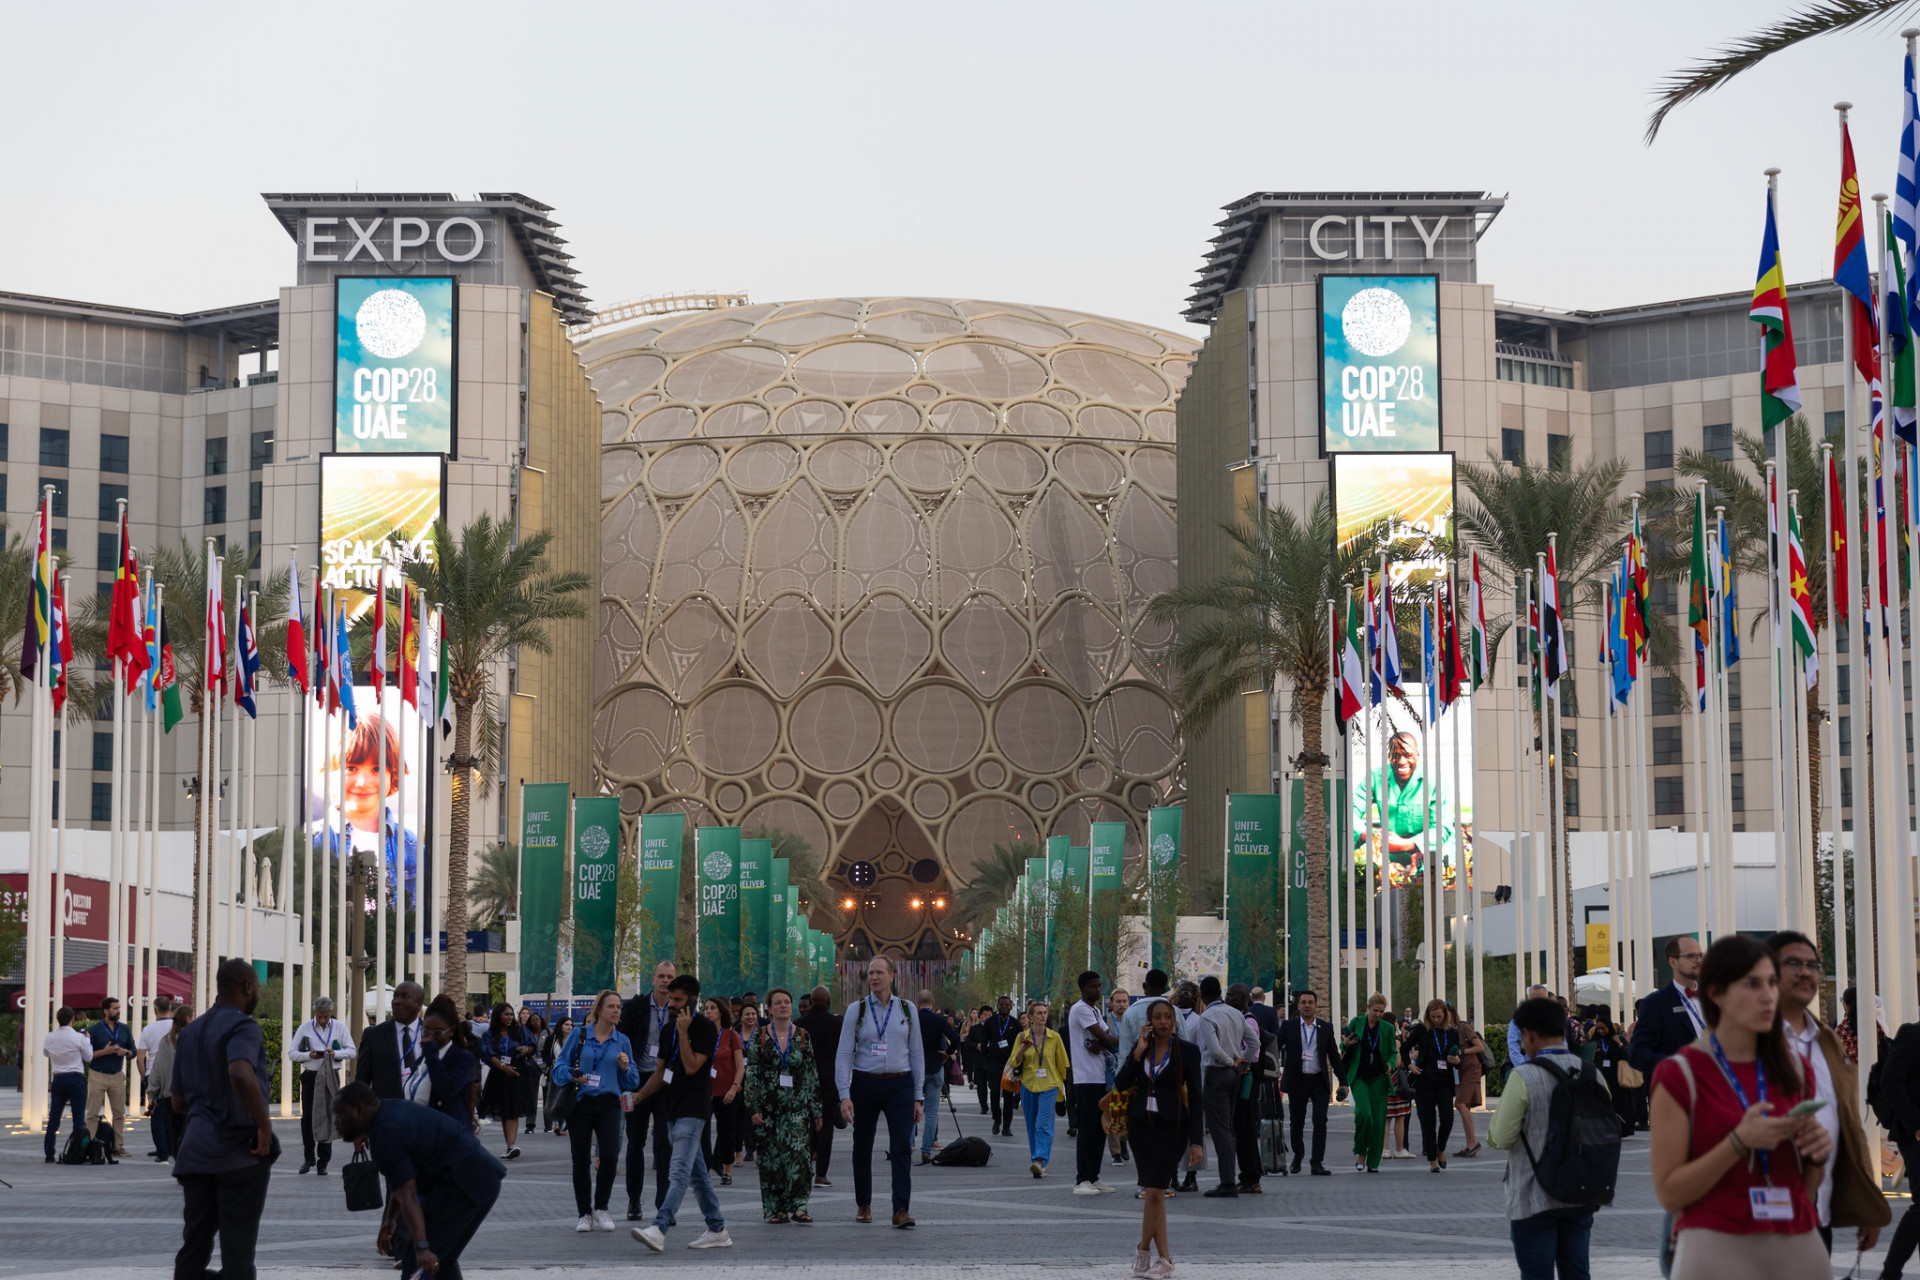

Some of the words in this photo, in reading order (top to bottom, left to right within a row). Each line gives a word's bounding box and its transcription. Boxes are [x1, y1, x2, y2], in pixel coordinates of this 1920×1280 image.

[305, 217, 484, 263] EXPO
[1309, 215, 1449, 260] CITY
[353, 367, 437, 403] COP28
[1341, 365, 1424, 401] COP28
[353, 404, 408, 439] UAE
[1342, 402, 1396, 437] UAE
[527, 811, 551, 821] UNITE.
[526, 824, 541, 834] ACT.
[1234, 821, 1262, 831] UNITE.
[526, 836, 558, 846] DELIVER.
[645, 839, 668, 848] UNITE.
[1234, 832, 1252, 842] ACT.
[644, 849, 660, 858] ACT.
[1234, 844, 1271, 854] DELIVER.
[644, 860, 675, 869] DELIVER.
[579, 864, 615, 881] COP28
[579, 882, 601, 899] UAE
[703, 884, 737, 900] COP28
[703, 900, 725, 915] UAE
